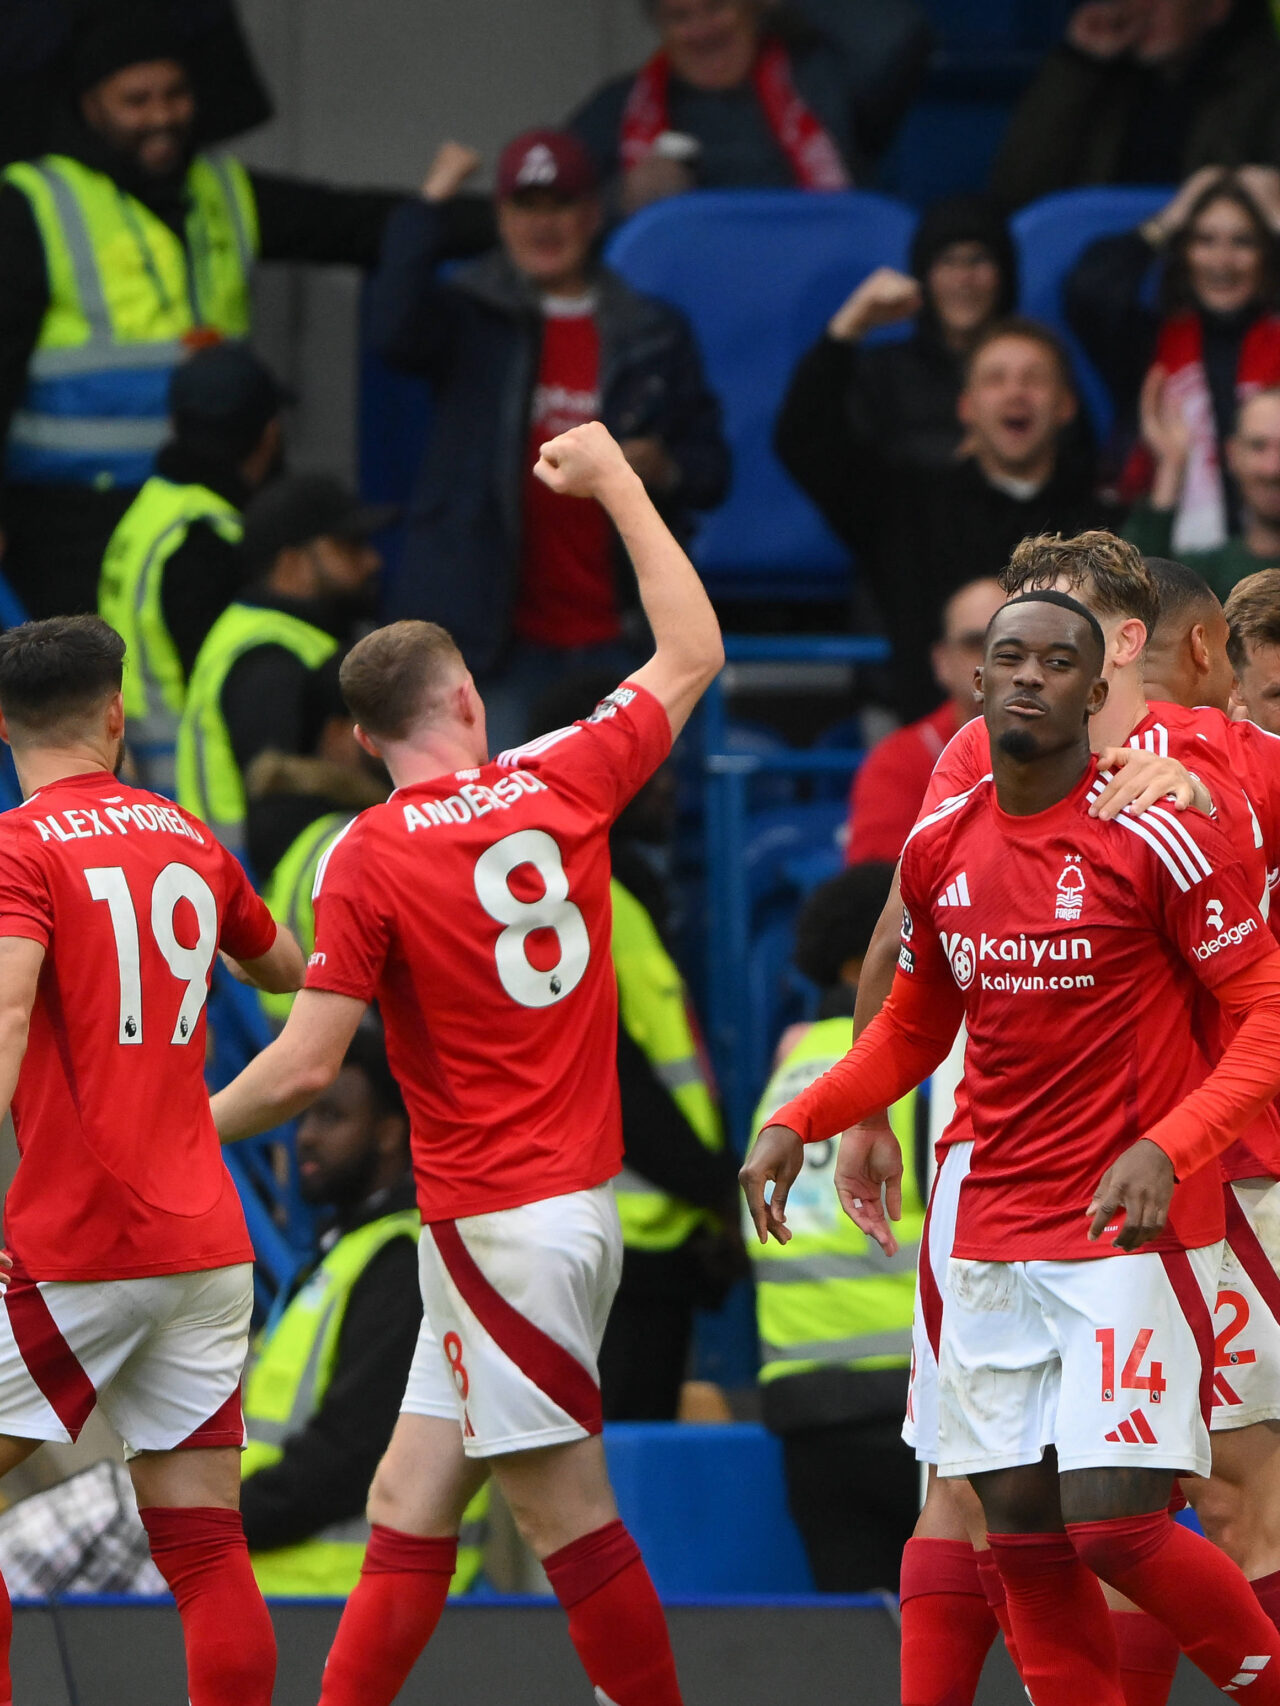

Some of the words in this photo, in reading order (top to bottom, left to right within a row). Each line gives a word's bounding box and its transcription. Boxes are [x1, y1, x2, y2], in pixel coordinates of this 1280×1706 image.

[32, 808, 113, 842] ALEX
[83, 861, 218, 1046] 19
[473, 828, 591, 1009] 8
[1191, 917, 1258, 963] Ideagen
[980, 972, 1095, 994] kaiyun.com
[443, 1330, 470, 1402] 8
[1095, 1328, 1167, 1404] 14
